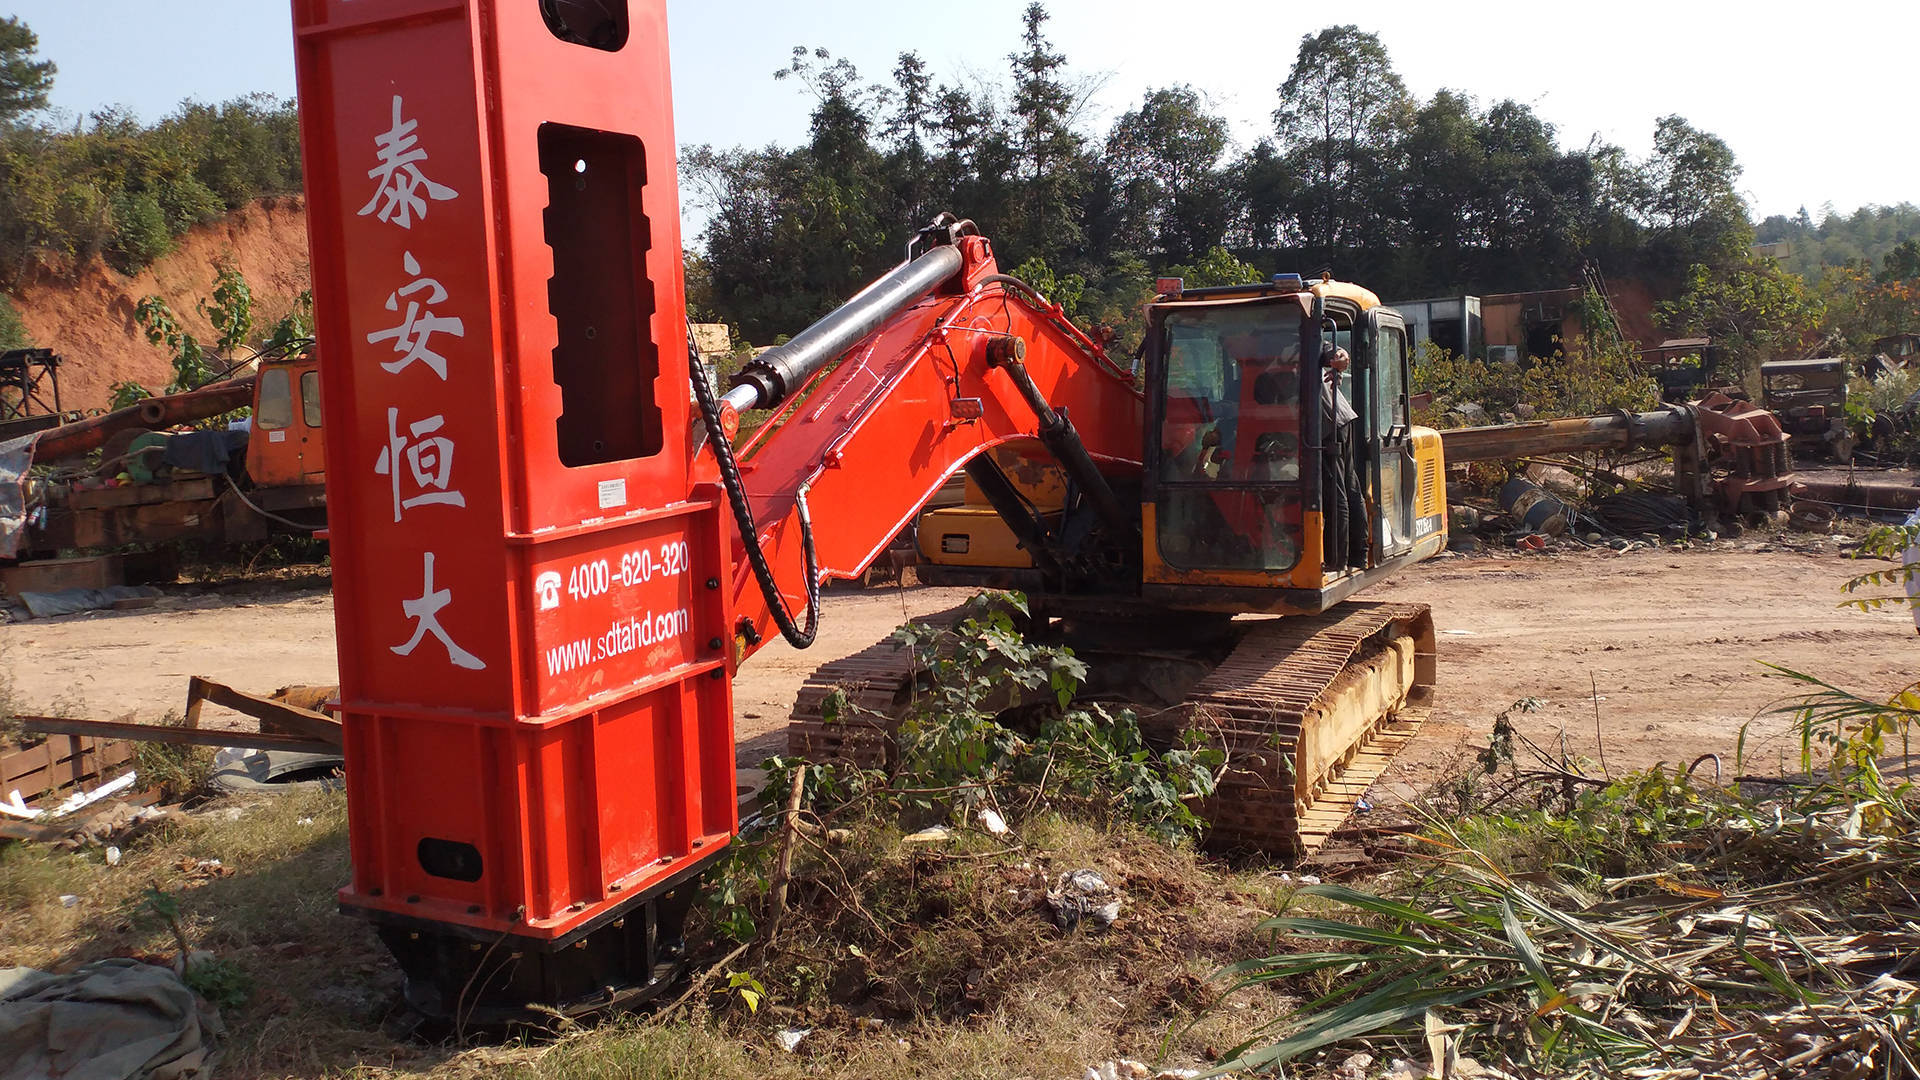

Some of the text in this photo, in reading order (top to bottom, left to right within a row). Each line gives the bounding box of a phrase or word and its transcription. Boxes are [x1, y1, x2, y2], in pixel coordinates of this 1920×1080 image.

[357, 95, 486, 670] 泰安恒大
[567, 540, 689, 602] 4000-620-320
[546, 607, 688, 677] www.sdtahd.com
